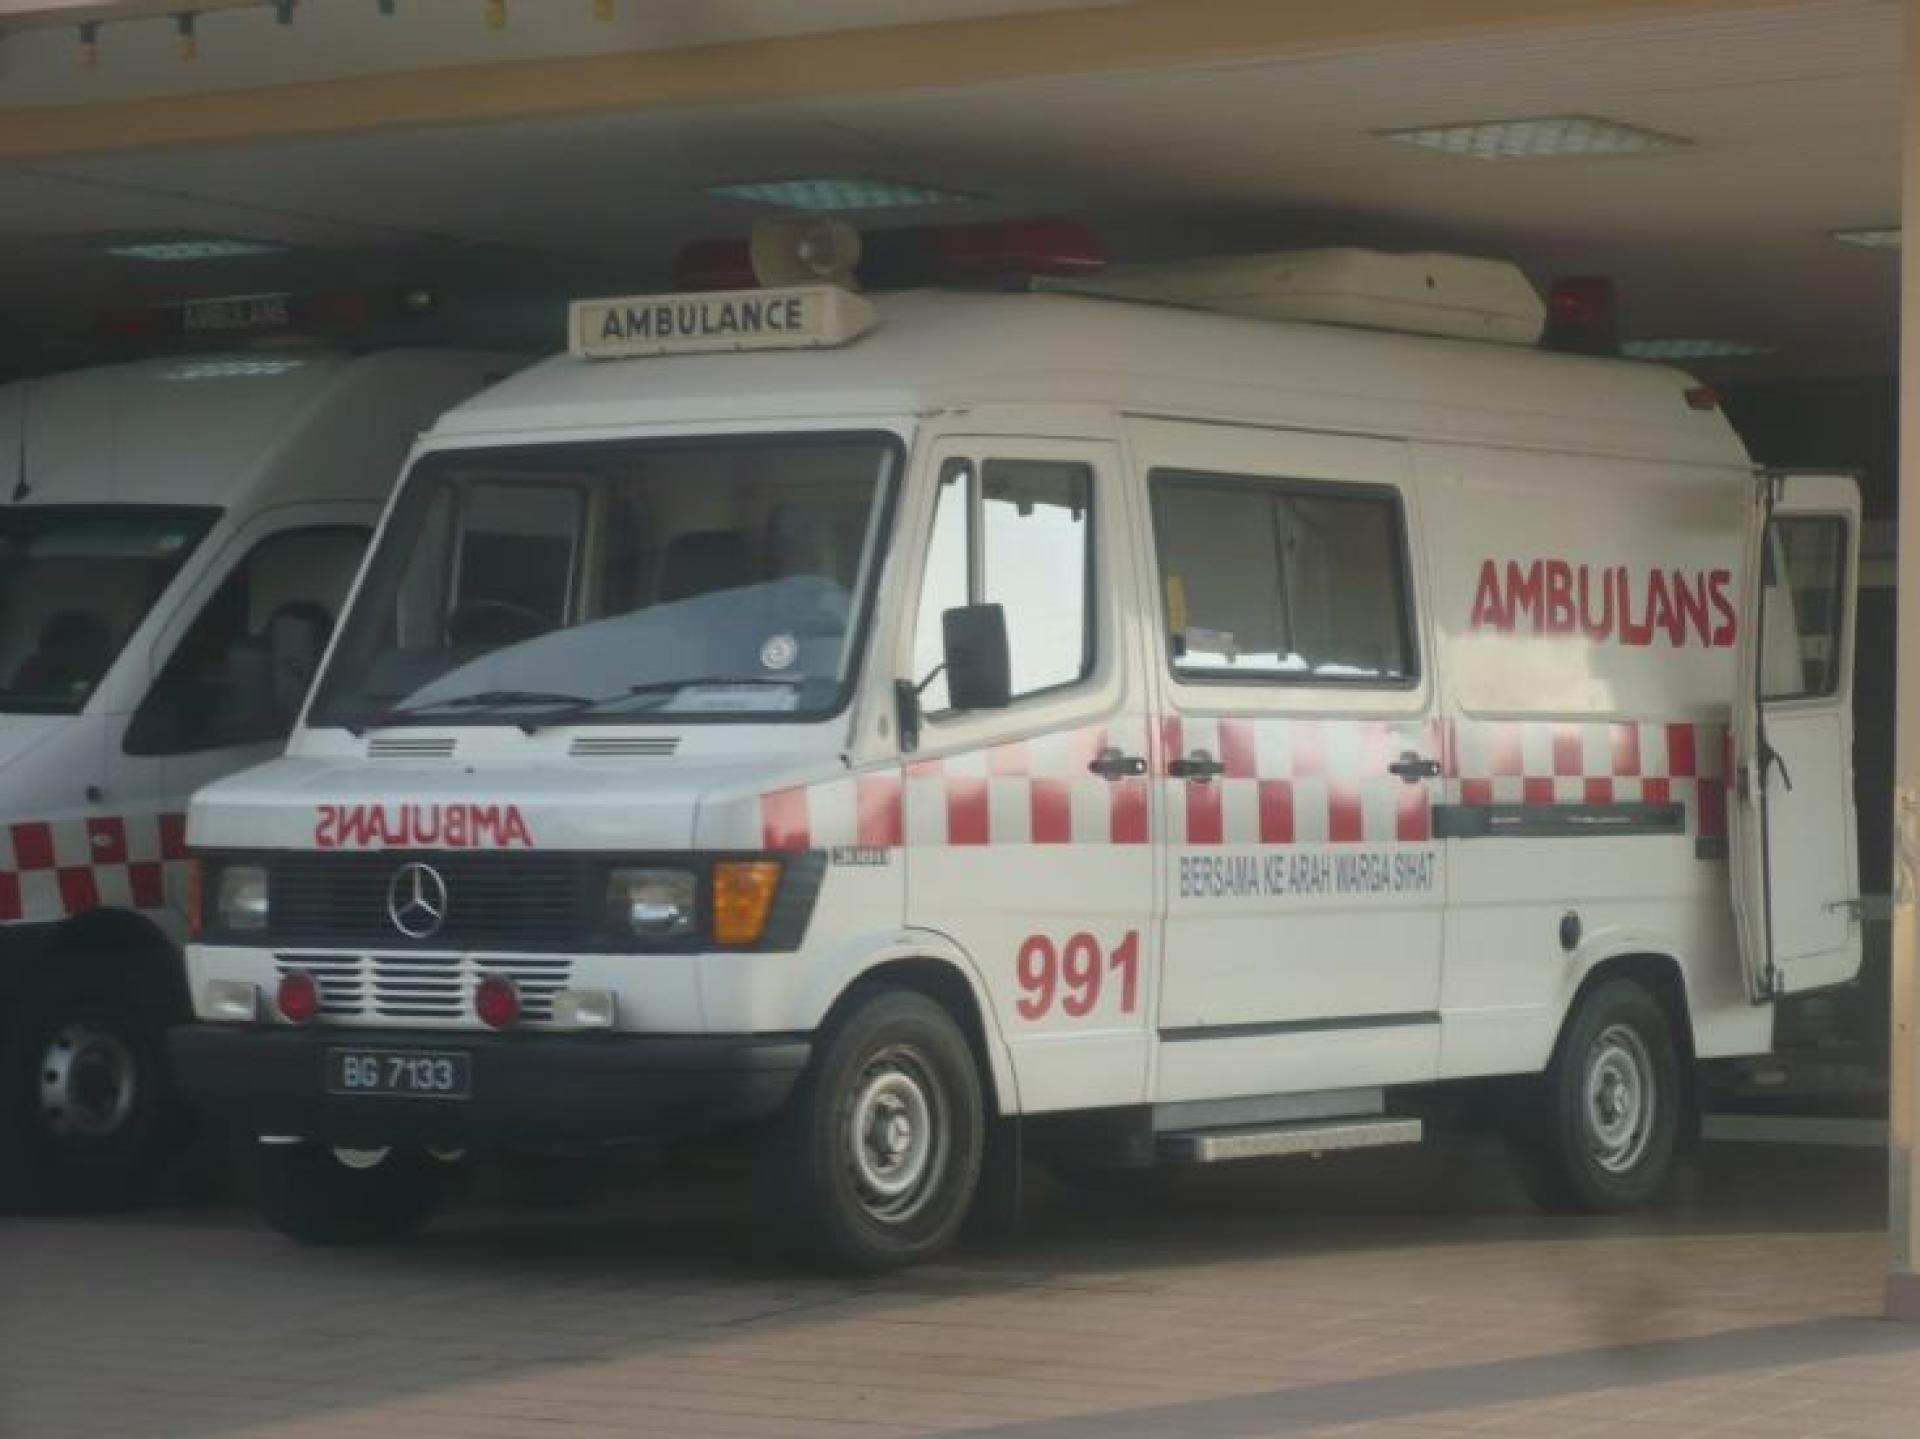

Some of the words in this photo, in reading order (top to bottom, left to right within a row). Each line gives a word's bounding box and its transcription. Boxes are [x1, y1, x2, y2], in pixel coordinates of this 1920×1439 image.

[602, 299, 802, 338] AMBULANCE
[1471, 558, 1737, 647] AMBULANS
[1180, 855, 1259, 897] BERSAMA
[1264, 855, 1284, 894] KE
[1289, 853, 1331, 894] ARAH
[1334, 853, 1392, 893] WARGA
[1395, 852, 1434, 891] SIHAT
[1016, 929, 1139, 1019] 991
[344, 1055, 376, 1088] BG
[385, 1057, 453, 1090] 7133
